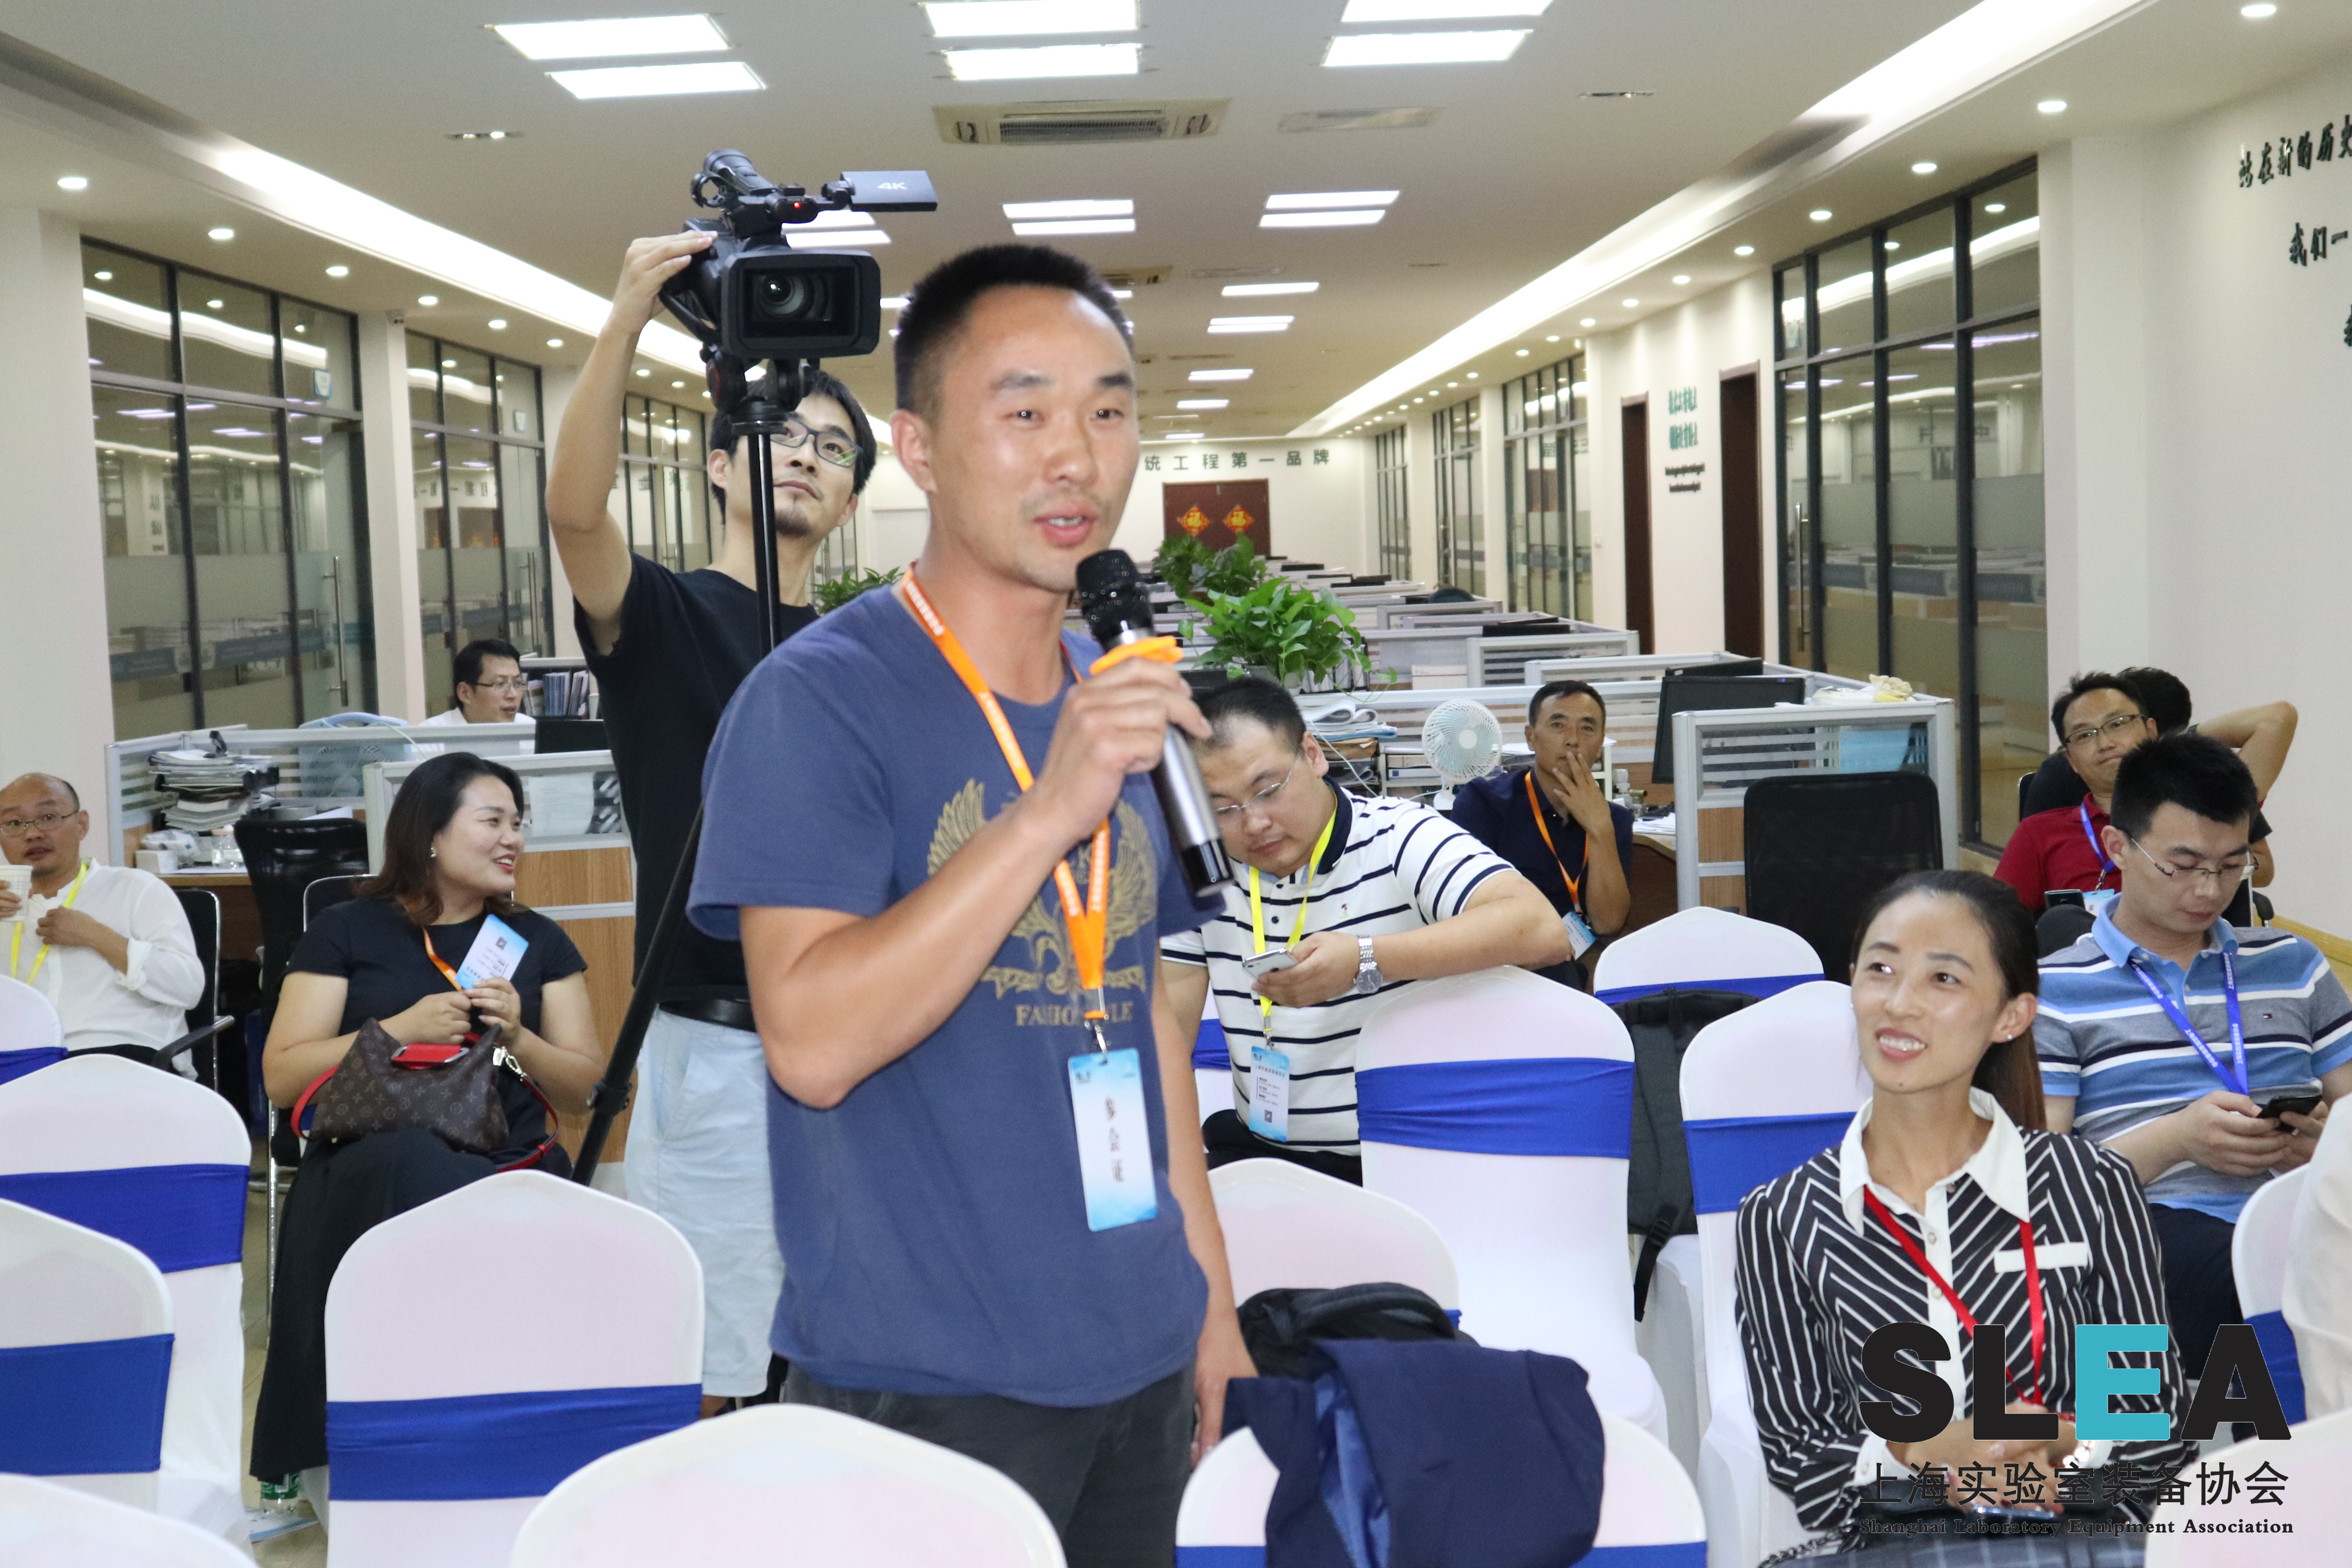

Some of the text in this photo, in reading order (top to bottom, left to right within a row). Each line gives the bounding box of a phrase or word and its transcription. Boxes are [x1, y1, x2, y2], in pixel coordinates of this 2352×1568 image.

[1144, 448, 1330, 471] 统工程第一品牌
